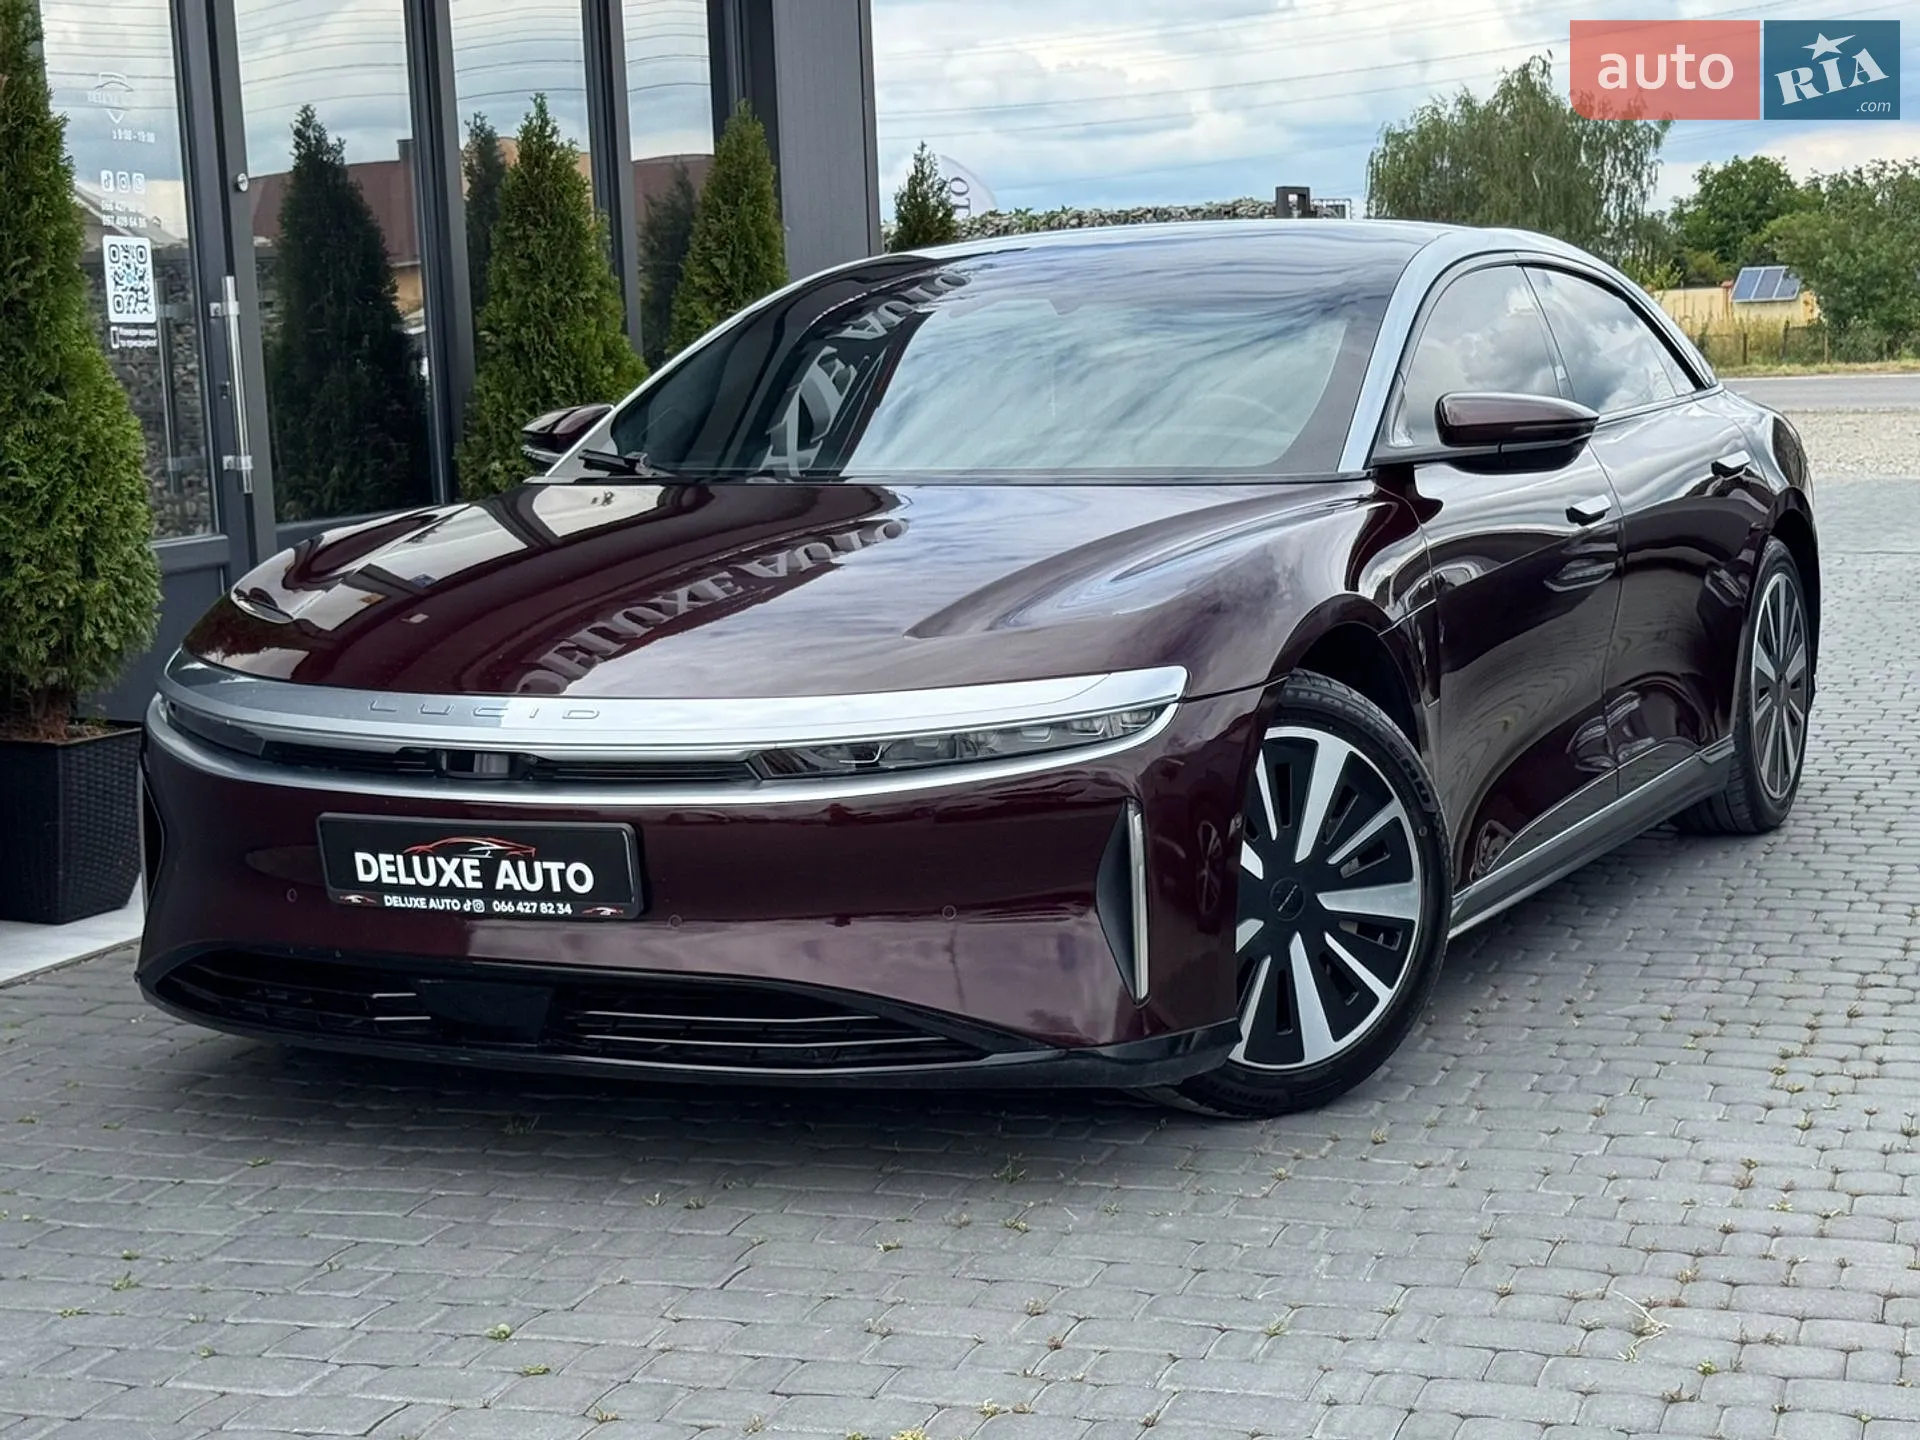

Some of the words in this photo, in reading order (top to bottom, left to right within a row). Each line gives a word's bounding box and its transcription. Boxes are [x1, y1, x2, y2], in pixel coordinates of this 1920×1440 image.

[369, 699, 600, 720] LUCID
[354, 851, 483, 889] DELUXE
[495, 859, 594, 894] AUTO
[384, 895, 427, 908] DELUXE
[429, 898, 460, 911] AUTO
[493, 900, 515, 913] 066
[517, 901, 537, 914] 427
[540, 903, 555, 914] 82
[557, 903, 573, 915] 34
